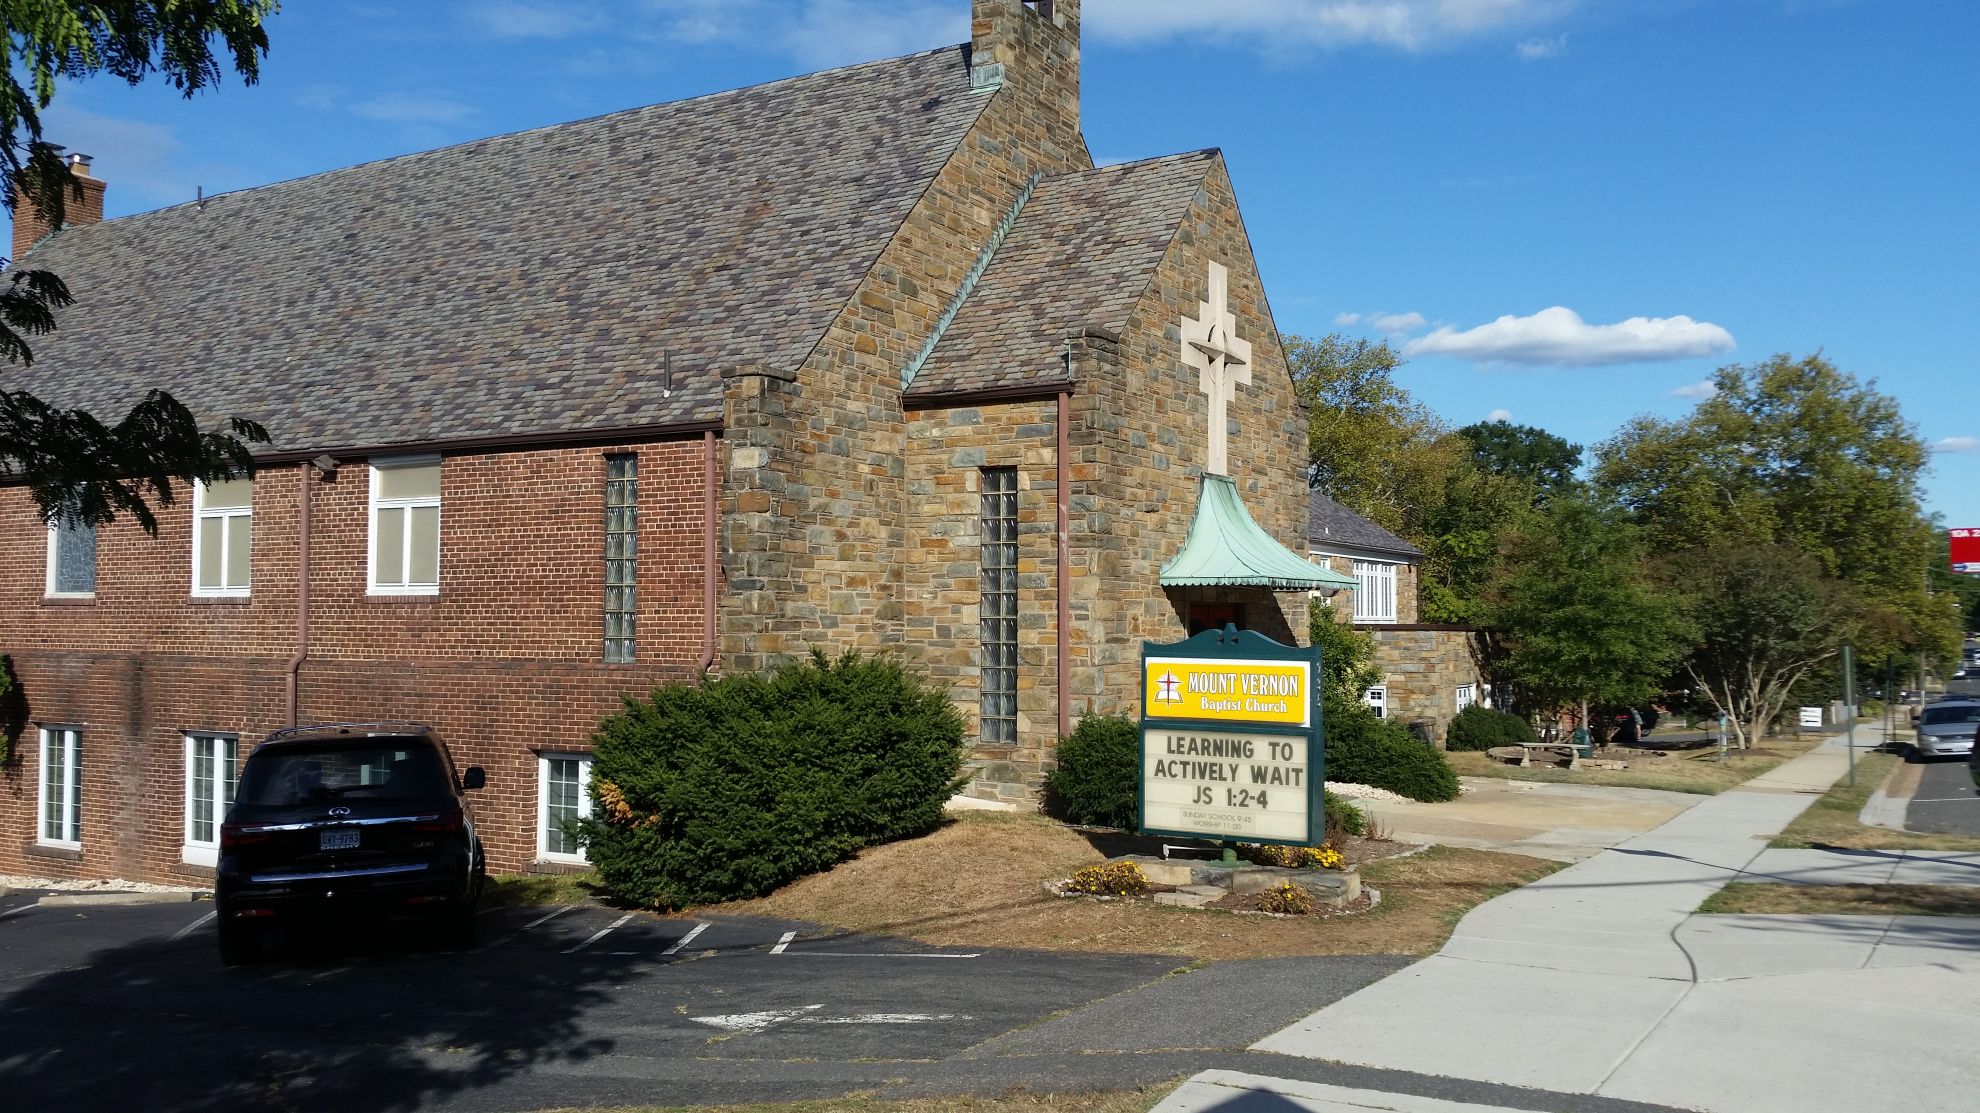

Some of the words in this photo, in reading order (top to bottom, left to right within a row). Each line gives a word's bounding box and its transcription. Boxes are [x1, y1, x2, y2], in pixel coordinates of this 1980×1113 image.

[1188, 672, 1238, 694] MOUNT
[1240, 673, 1299, 697] VERNON
[1200, 696, 1242, 713] Baptist
[1245, 698, 1288, 713] Church
[1167, 736, 1255, 759] LEARNING
[1268, 741, 1294, 762] TO
[1154, 759, 1239, 782] ACTIVELY
[1250, 765, 1304, 786] WAIT
[1192, 785, 1213, 805] JS
[1226, 788, 1269, 809] 1:2-4
[1182, 810, 1206, 819] SUNDAY
[1207, 812, 1237, 822] SCHOOL
[1192, 819, 1221, 828] WORSHIP
